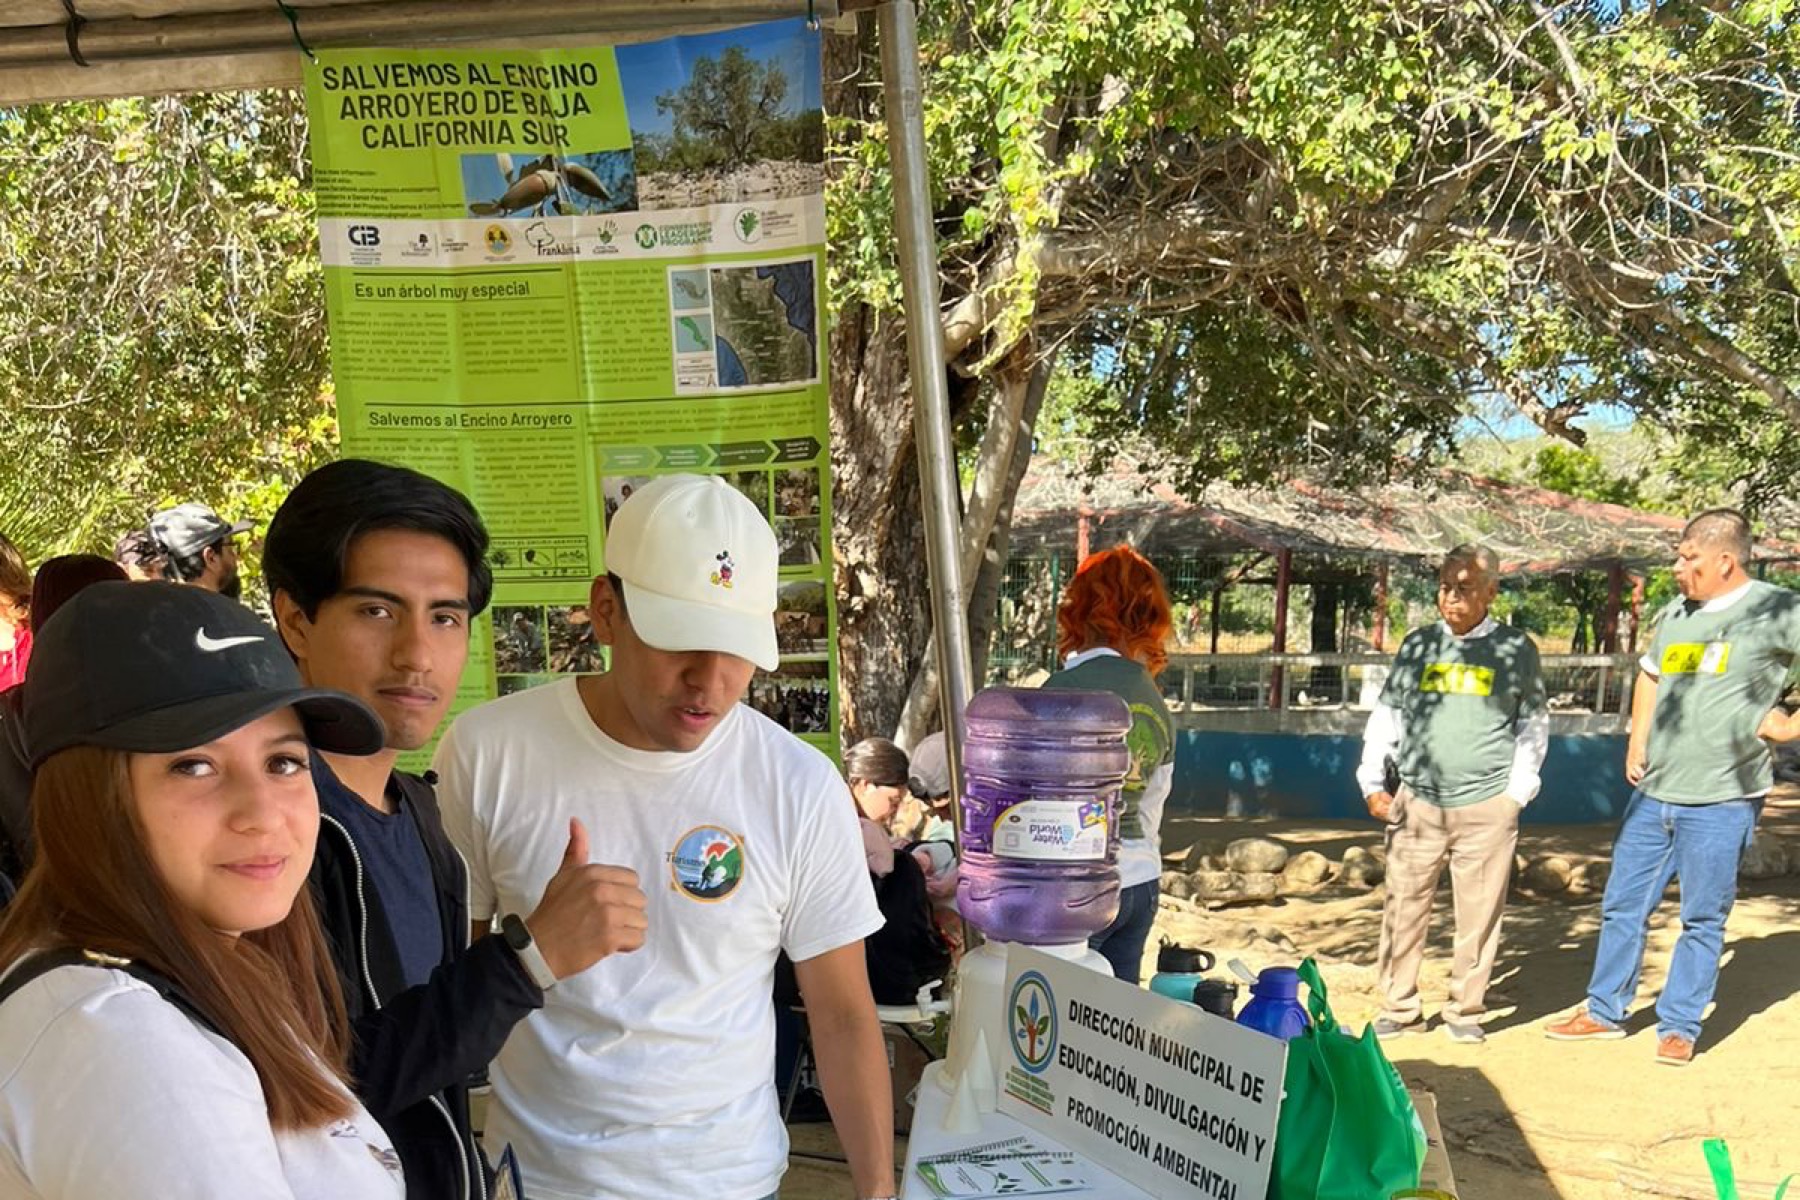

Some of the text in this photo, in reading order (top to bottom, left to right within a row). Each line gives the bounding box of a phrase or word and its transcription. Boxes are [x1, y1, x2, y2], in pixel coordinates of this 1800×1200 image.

[323, 62, 598, 91] SALVEMOS AL ENCINO
[340, 89, 591, 121] ARROYERO DE BAJA
[361, 119, 571, 149] CALIFORNIA SUR
[355, 281, 530, 300] Es un árbol muy especial
[369, 412, 573, 430] Salvemos al Encino Arroyero
[1028, 824, 1063, 834] World
[1032, 834, 1066, 845] Water
[1068, 999, 1265, 1104] DIRECCIÓN MUNICIPAL DE
[1057, 1043, 1141, 1108] EDUCACIÓN,
[1143, 1081, 1250, 1156] DIVULGACIÓN
[1252, 1133, 1267, 1163] Y
[1066, 1096, 1151, 1155] PROMOCIÓN
